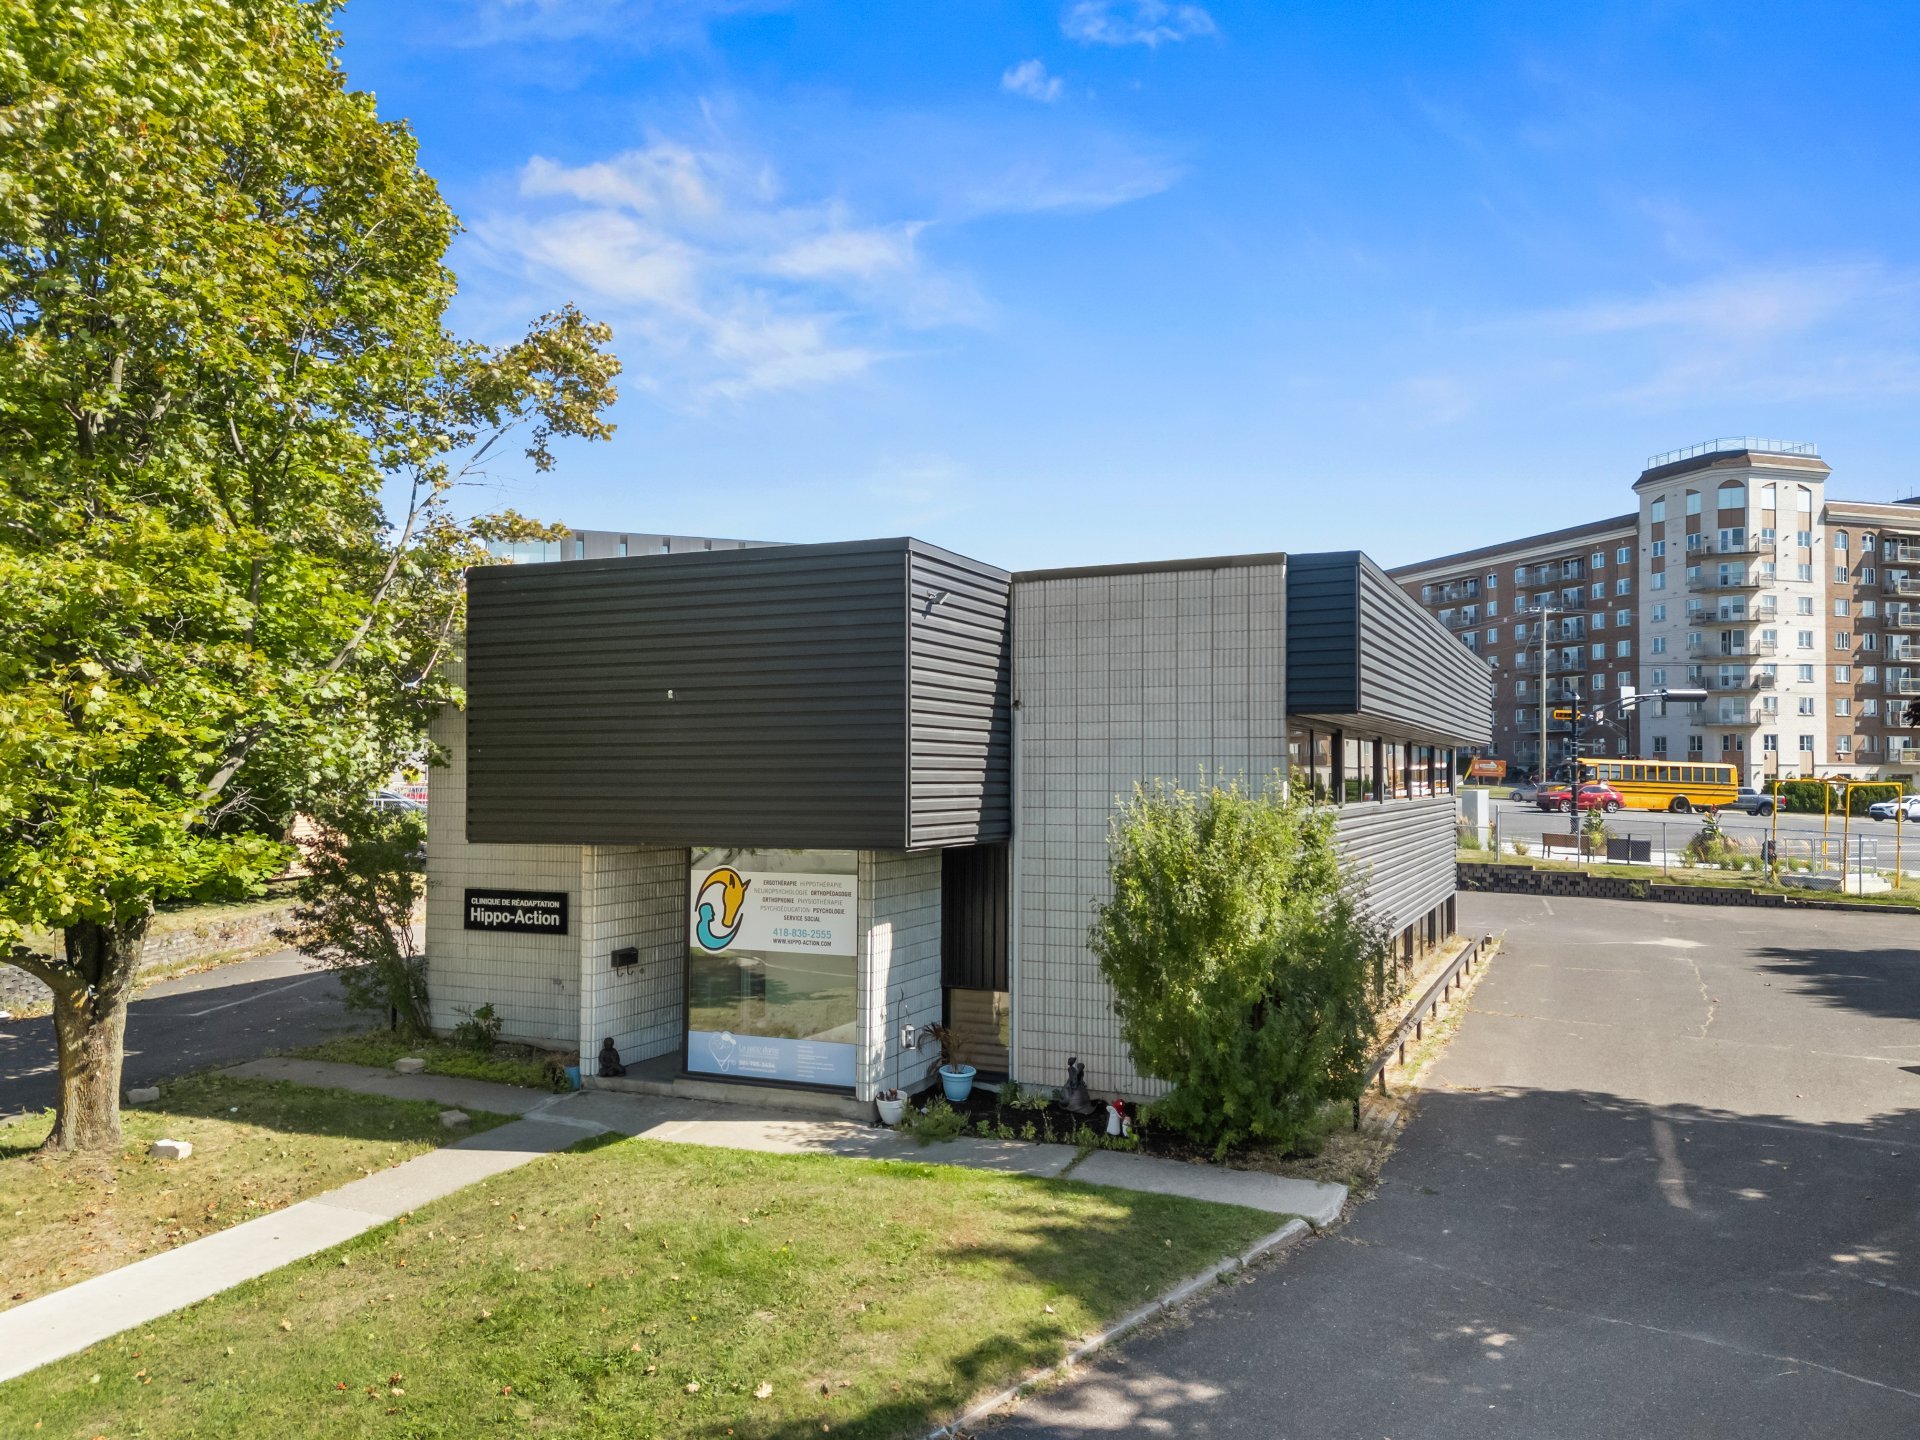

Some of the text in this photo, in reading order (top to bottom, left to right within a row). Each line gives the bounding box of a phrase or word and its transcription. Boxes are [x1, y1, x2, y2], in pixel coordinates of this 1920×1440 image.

[511, 898, 560, 908] RÉADAPTATION
[470, 907, 560, 926] Hippo-Action
[773, 928, 832, 939] 418-836-2555
